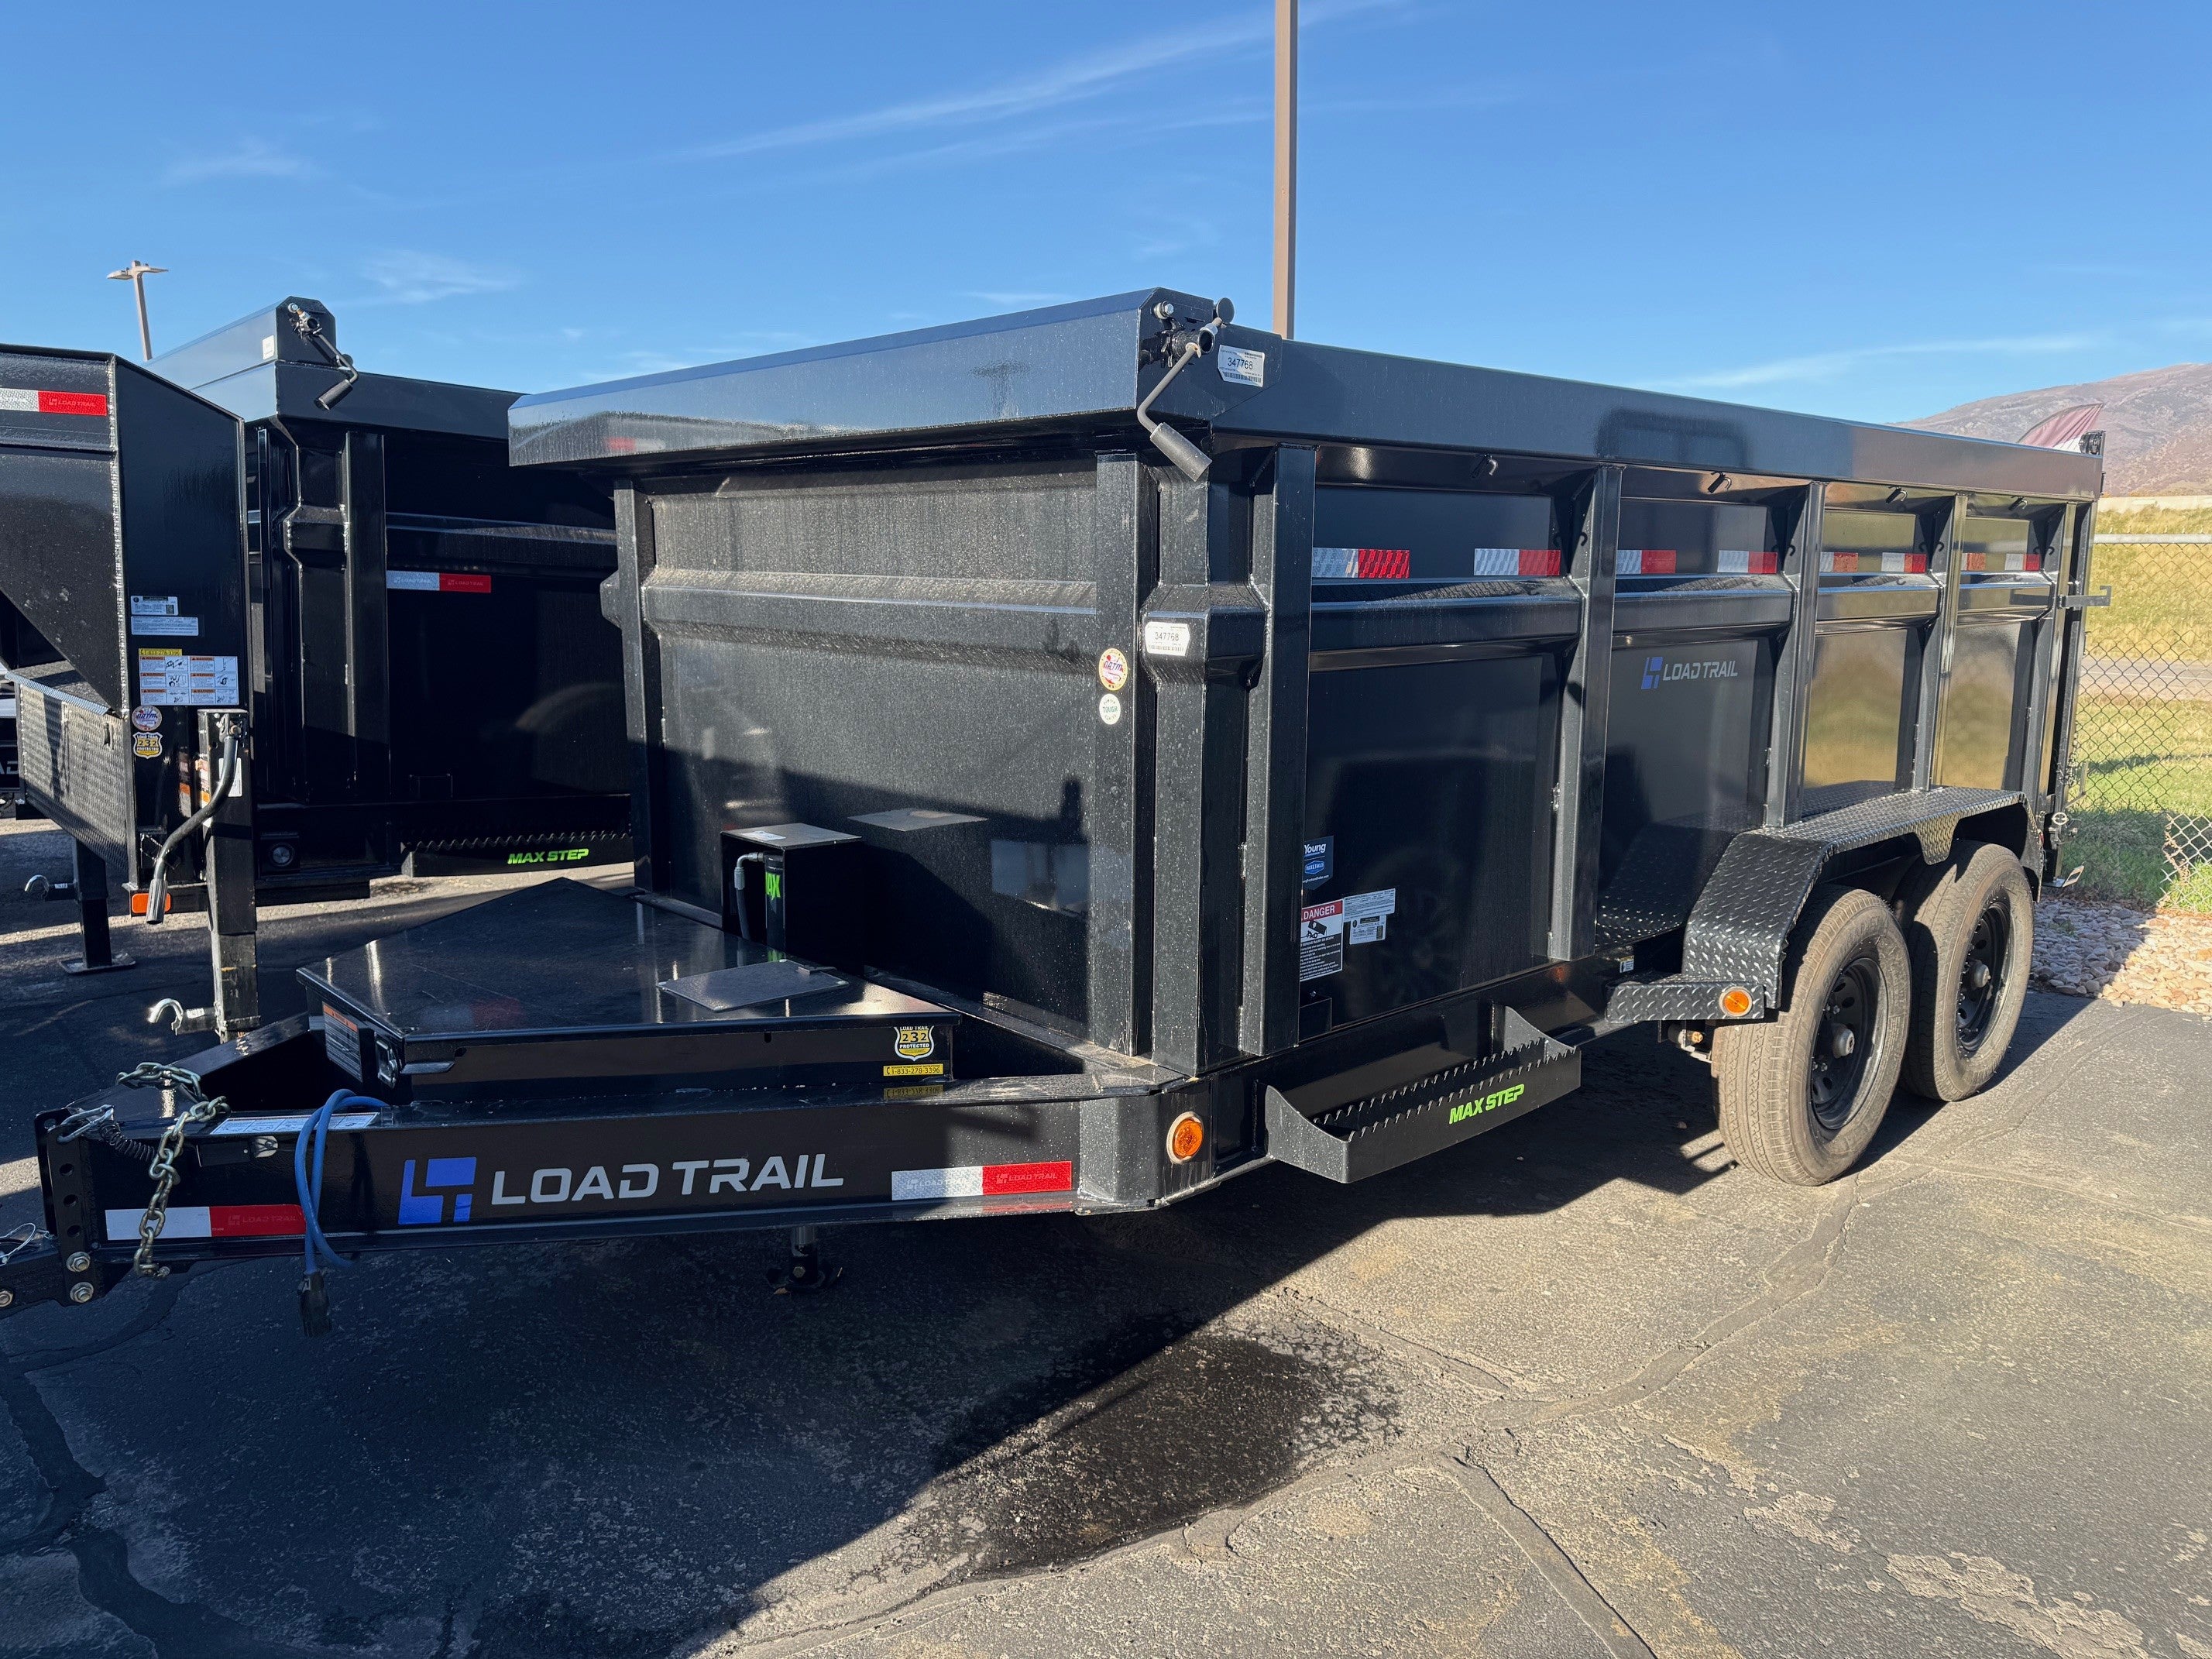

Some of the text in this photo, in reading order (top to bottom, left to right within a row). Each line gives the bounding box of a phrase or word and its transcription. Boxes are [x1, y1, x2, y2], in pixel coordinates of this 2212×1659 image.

[1228, 357, 1253, 370] 347768
[1155, 631, 1180, 641] 347768
[1663, 661, 1738, 681] LOAD TRAIL
[507, 848, 589, 864] MAX STEP
[1304, 843, 1327, 854] Young
[1304, 905, 1335, 920] DANGER
[902, 1032, 927, 1042] 232
[1449, 1084, 1525, 1125] MAX STEP
[491, 1153, 845, 1205] LOAD TRAIL
